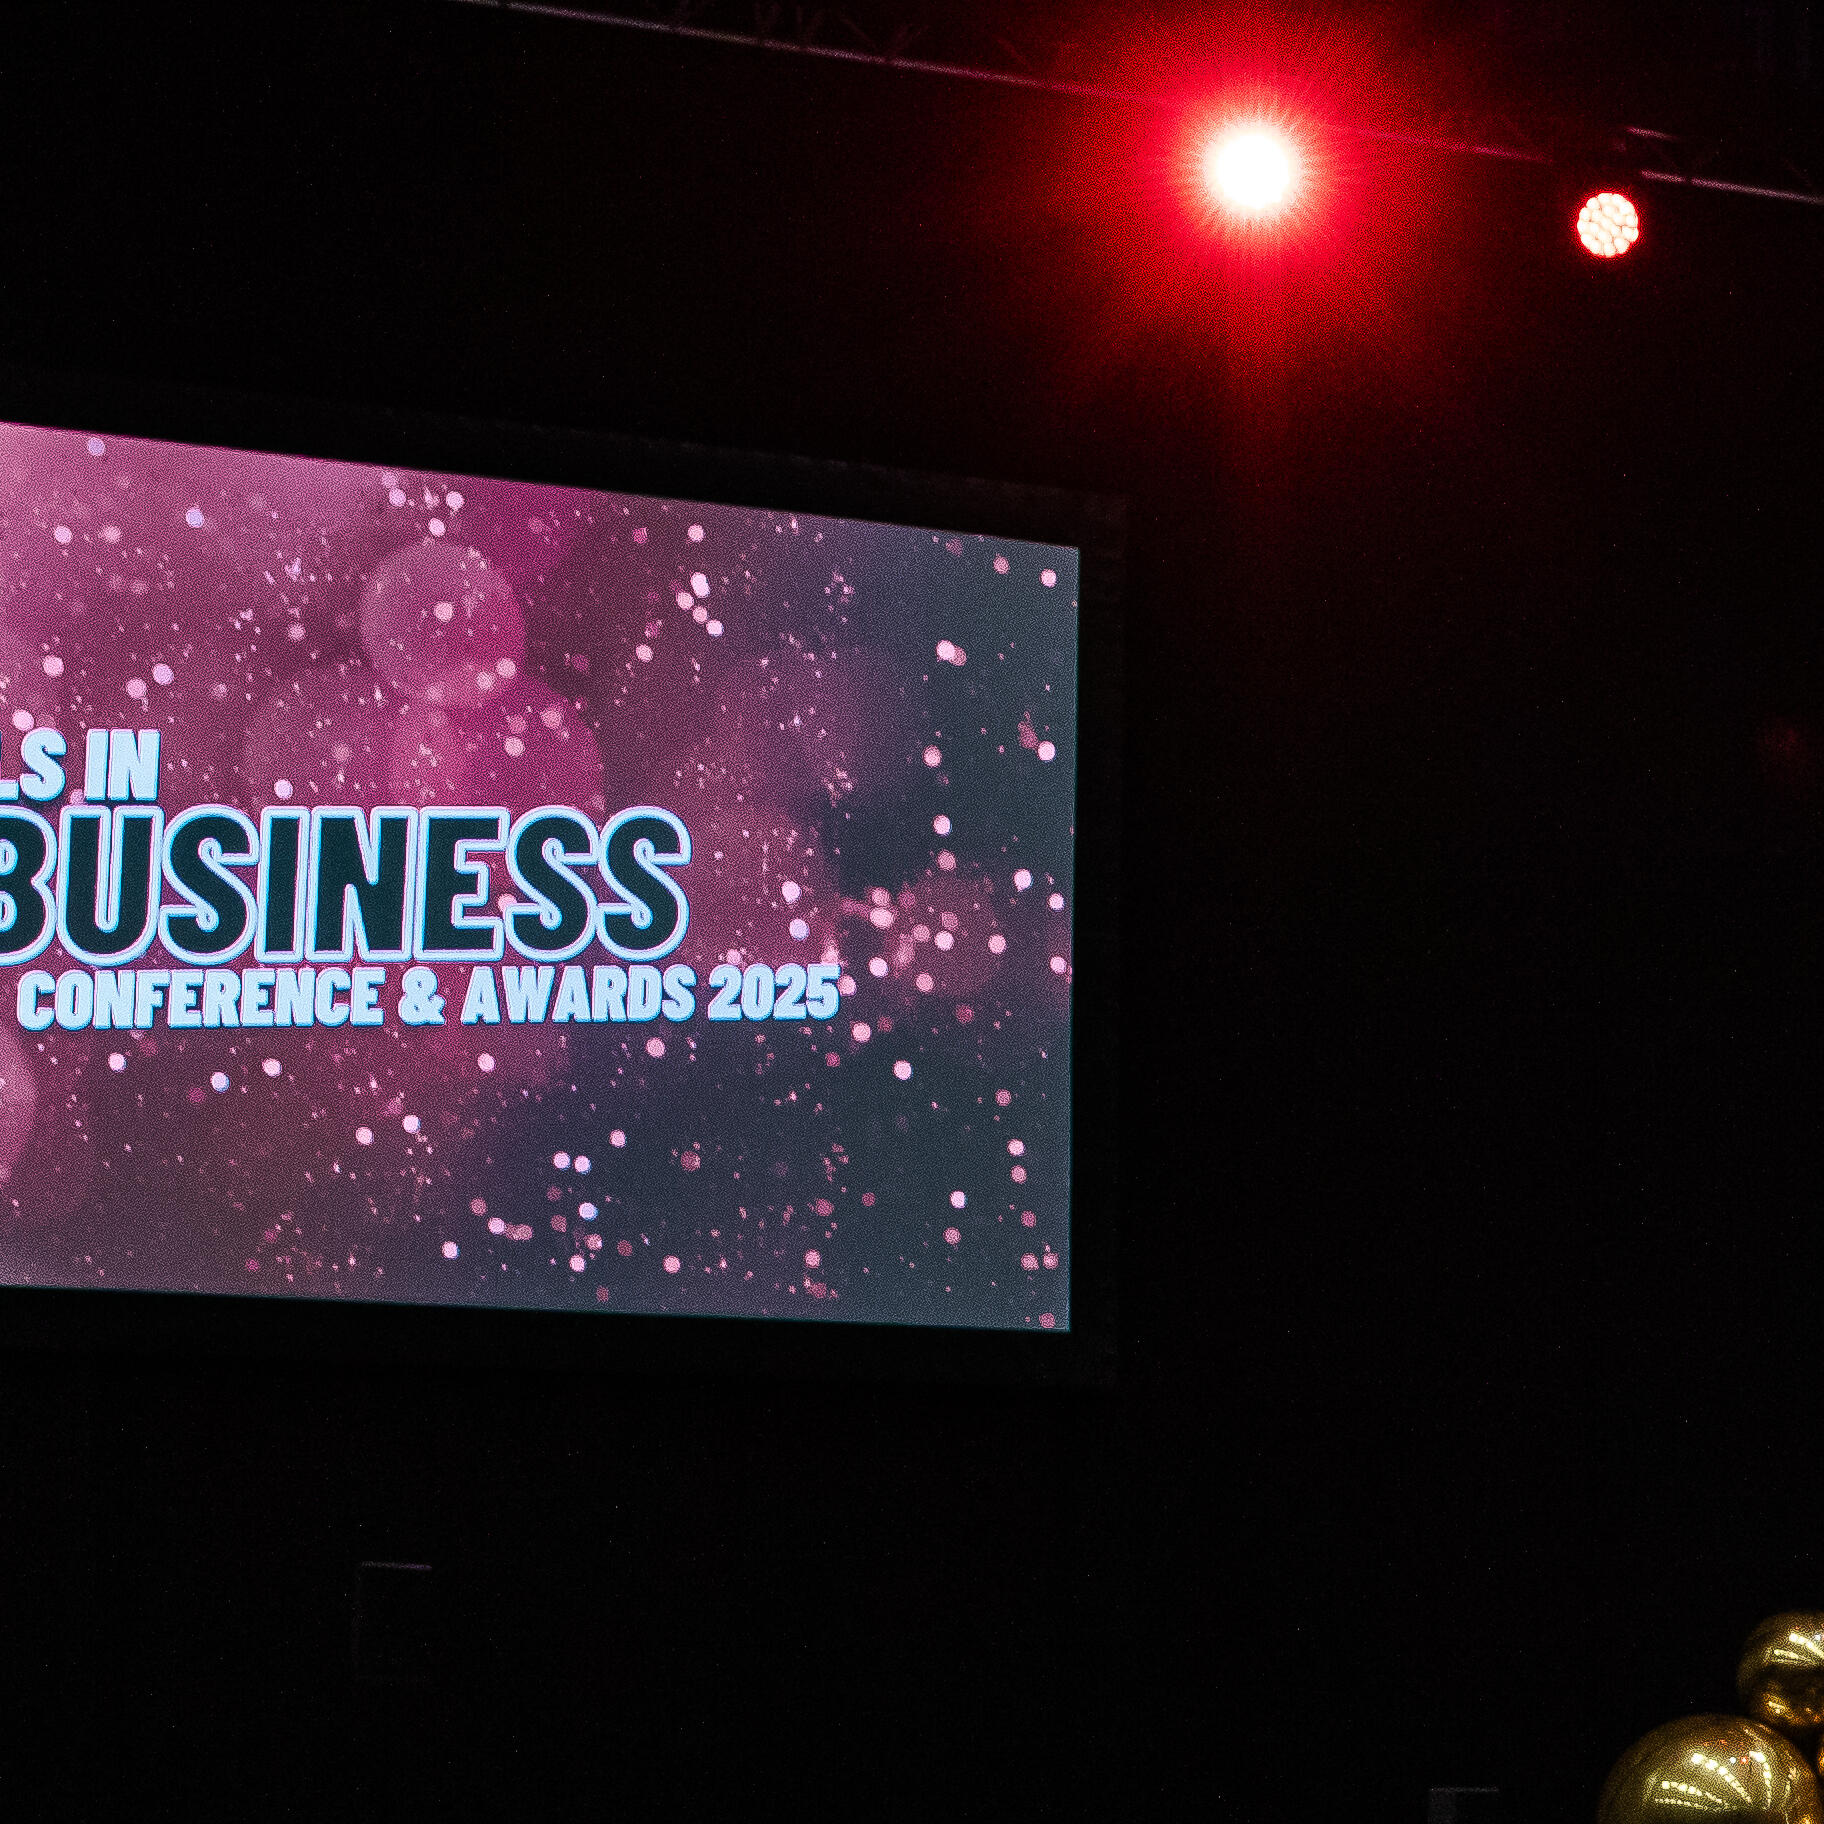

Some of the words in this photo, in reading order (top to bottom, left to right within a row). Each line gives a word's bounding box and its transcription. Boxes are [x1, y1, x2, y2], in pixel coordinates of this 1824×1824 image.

[83, 728, 162, 801] IN
[0, 805, 693, 966] BUSINESS
[16, 966, 387, 1031] CONFERENCE
[397, 967, 447, 1026] &
[460, 965, 697, 1025] AWARDS
[706, 963, 843, 1022] 2025
